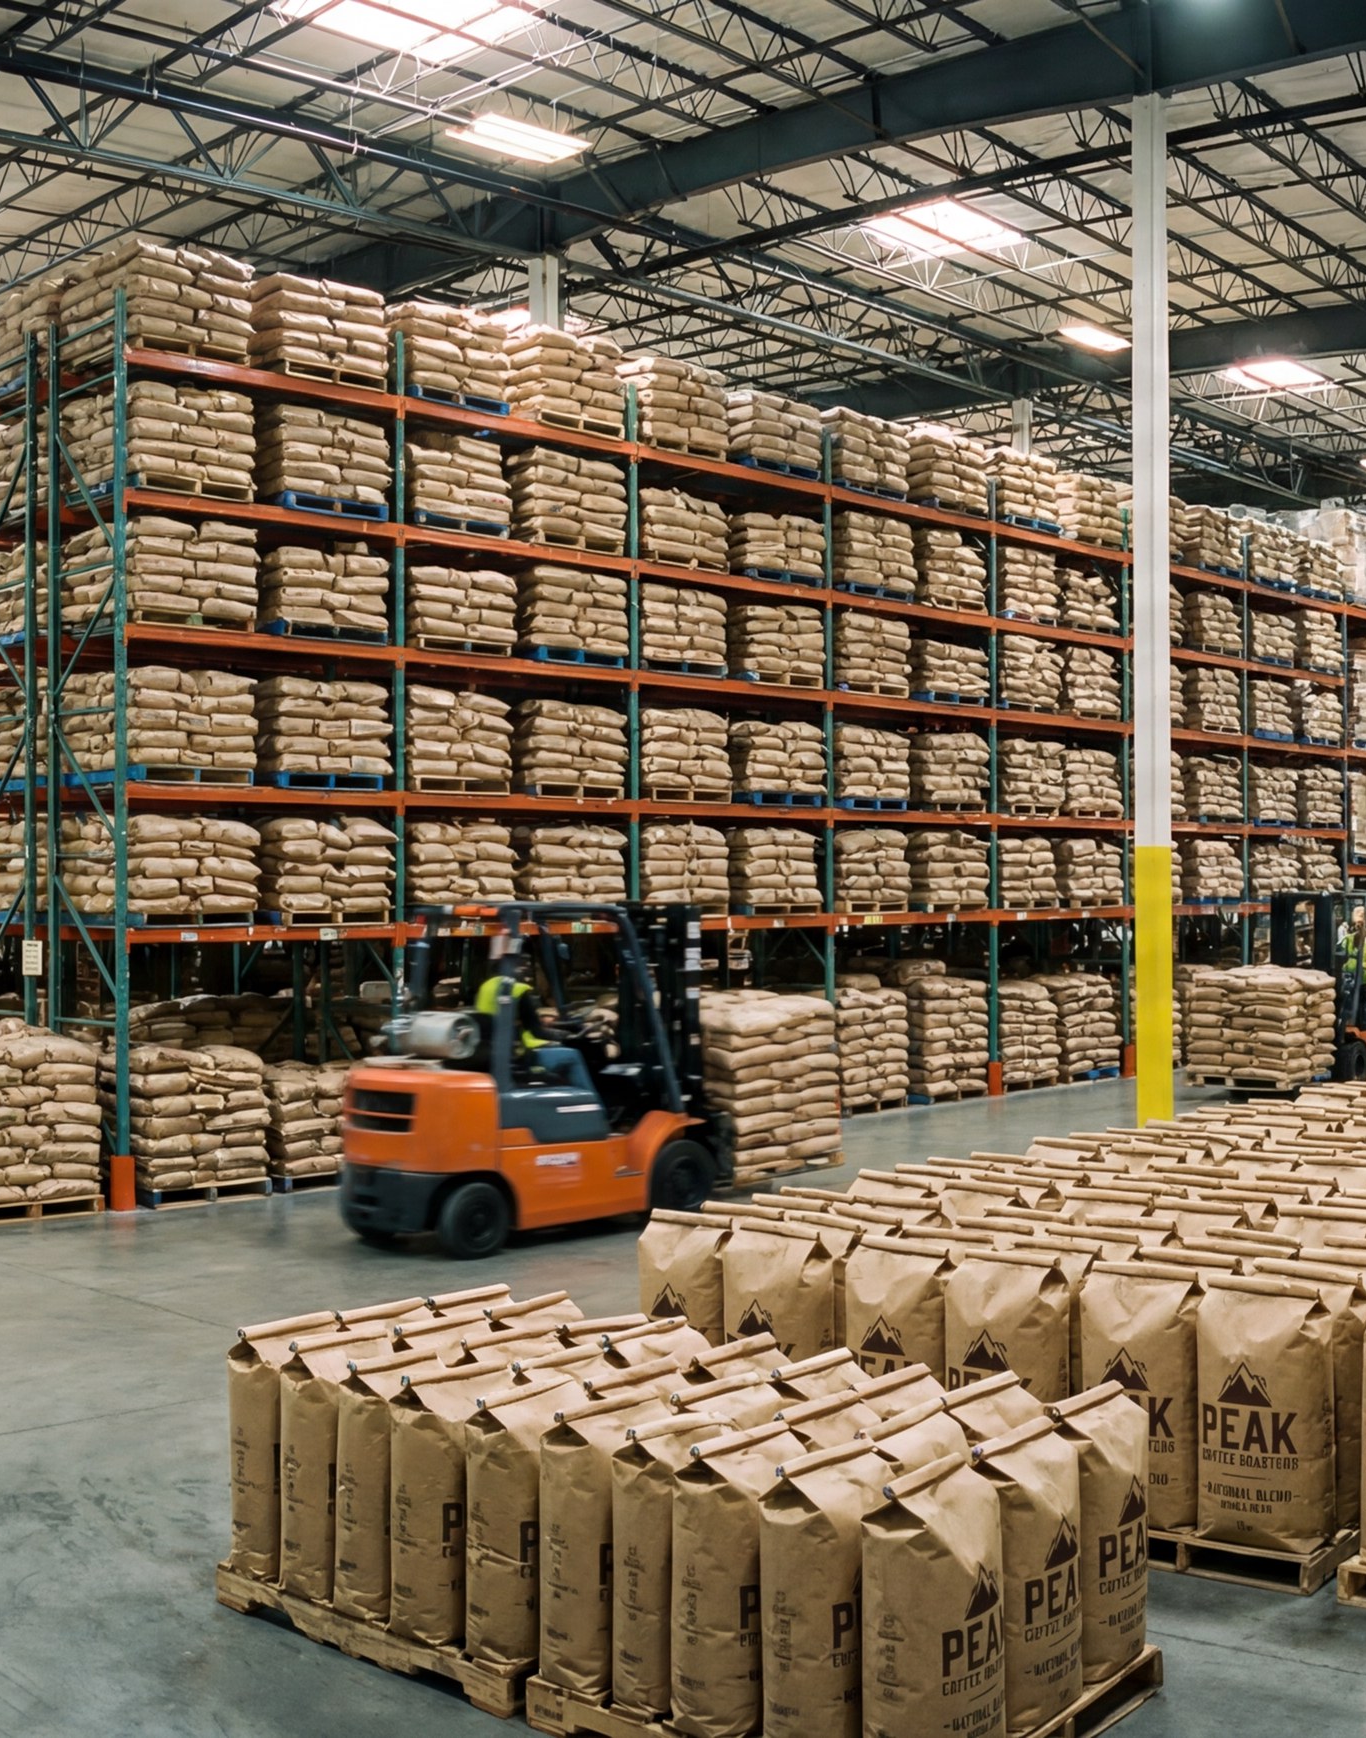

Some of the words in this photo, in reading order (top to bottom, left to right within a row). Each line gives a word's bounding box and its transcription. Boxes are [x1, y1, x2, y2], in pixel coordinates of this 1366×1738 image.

[1202, 1403, 1297, 1454] PEAK
[1099, 1516, 1148, 1578] PEA
[1025, 1556, 1081, 1626] PEA
